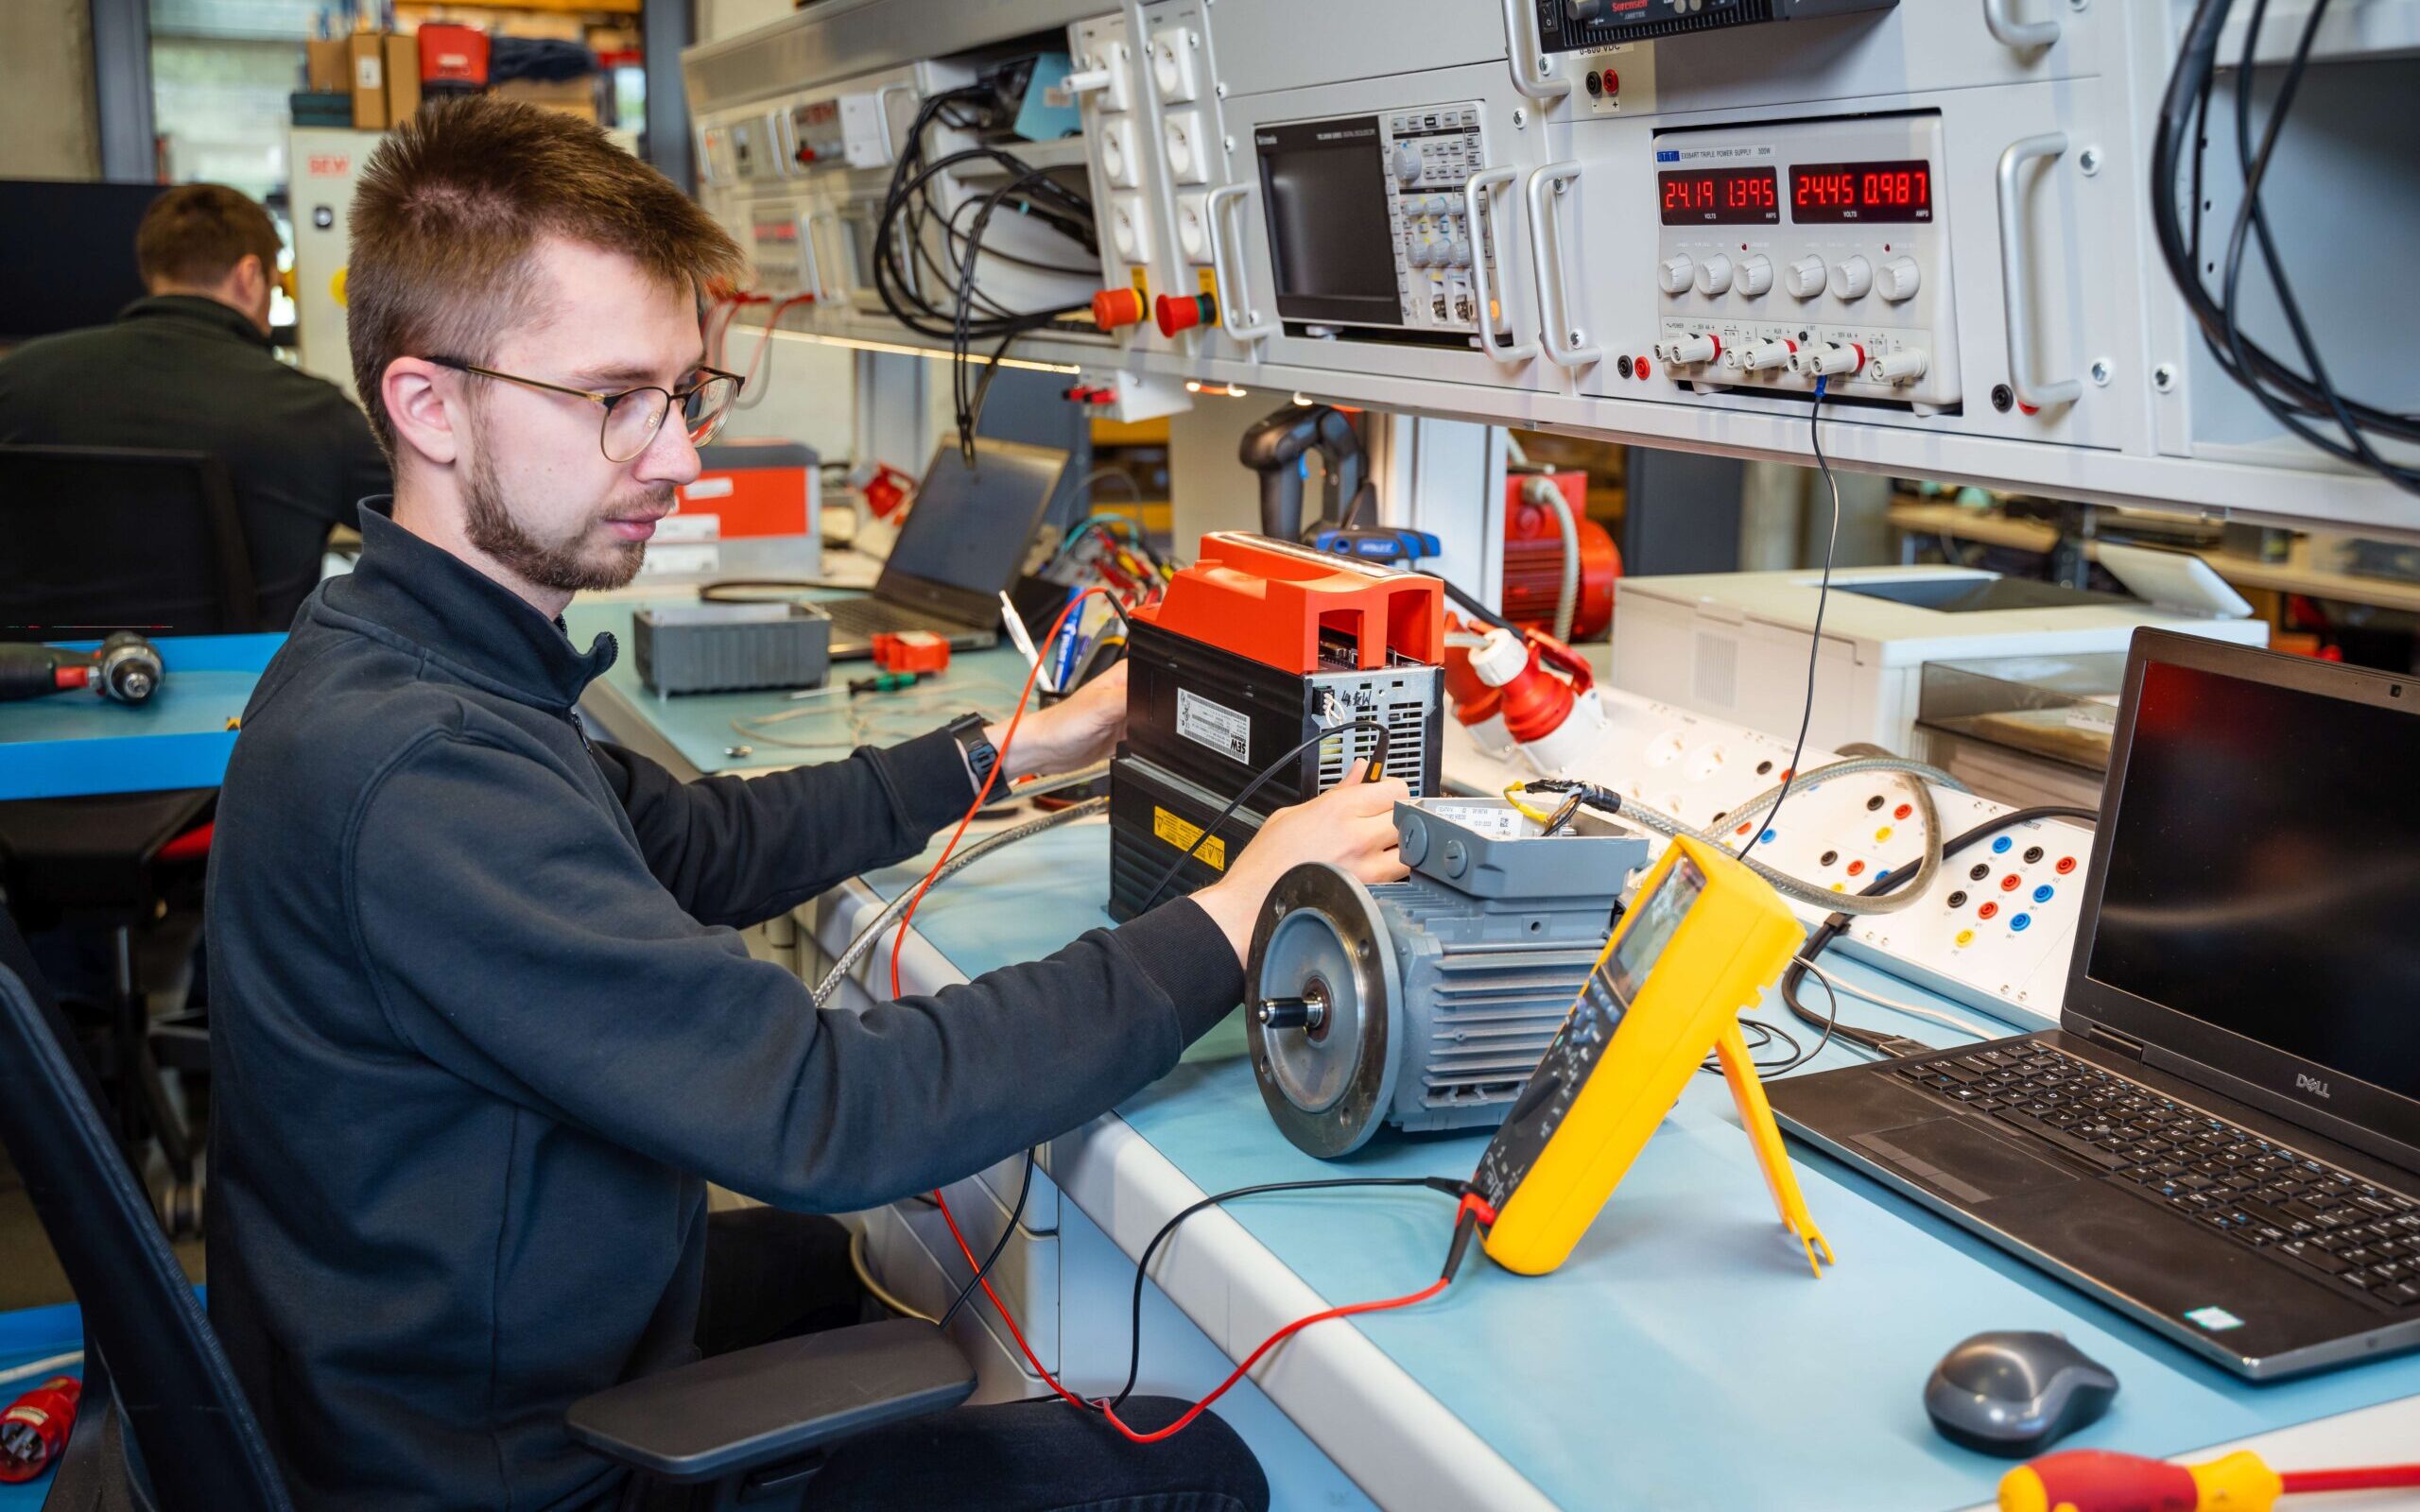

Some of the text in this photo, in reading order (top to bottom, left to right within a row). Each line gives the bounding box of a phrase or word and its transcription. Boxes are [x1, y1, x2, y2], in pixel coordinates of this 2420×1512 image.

[308, 154, 350, 177] SEW
[1717, 149, 1733, 158] POWER
[1666, 180, 1713, 209] 24.19
[1729, 179, 1773, 207] 1.395
[1797, 174, 1855, 205] 24.45
[1862, 172, 1927, 204] 0.987
[1230, 738, 1247, 755] SEW
[2295, 1073, 2330, 1099] DELL
